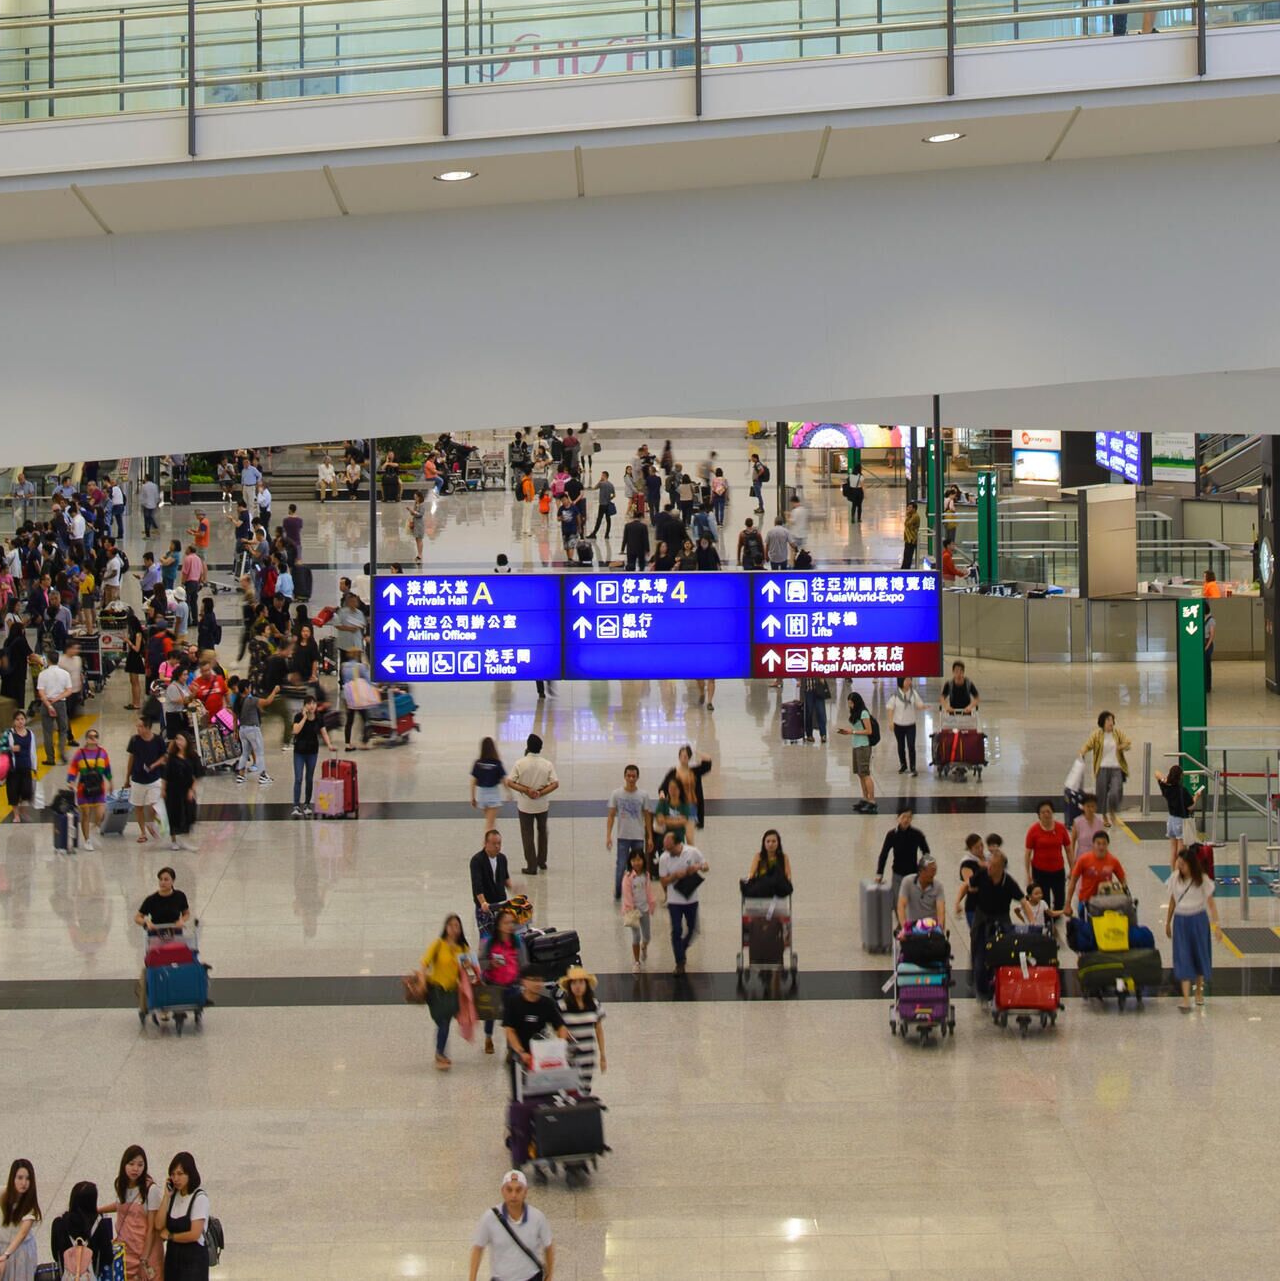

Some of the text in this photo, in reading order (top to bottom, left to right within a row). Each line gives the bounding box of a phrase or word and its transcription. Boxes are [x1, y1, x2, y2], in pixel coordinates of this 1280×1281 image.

[407, 580, 468, 595] 接機大堂
[622, 579, 668, 594] 停車場
[671, 580, 688, 603] 4
[811, 577, 936, 592] 往亞洲國際博覽館
[407, 595, 468, 606] Arrivals Hall
[472, 582, 494, 605] A
[622, 593, 664, 604] Car Park
[811, 592, 905, 603] To AsiaWorld-Expo
[407, 615, 517, 630] 航空公司辦公室
[622, 613, 653, 628] 銀行
[811, 611, 858, 626] 升降機
[407, 630, 477, 641] Airline Offices
[622, 628, 648, 639] Bank
[811, 627, 833, 637] Lifts
[484, 649, 531, 664] 洗手間
[811, 646, 904, 661] 富豪機場酒店
[484, 664, 517, 675] Toilets
[811, 661, 904, 673] Regal Airport Hotel
